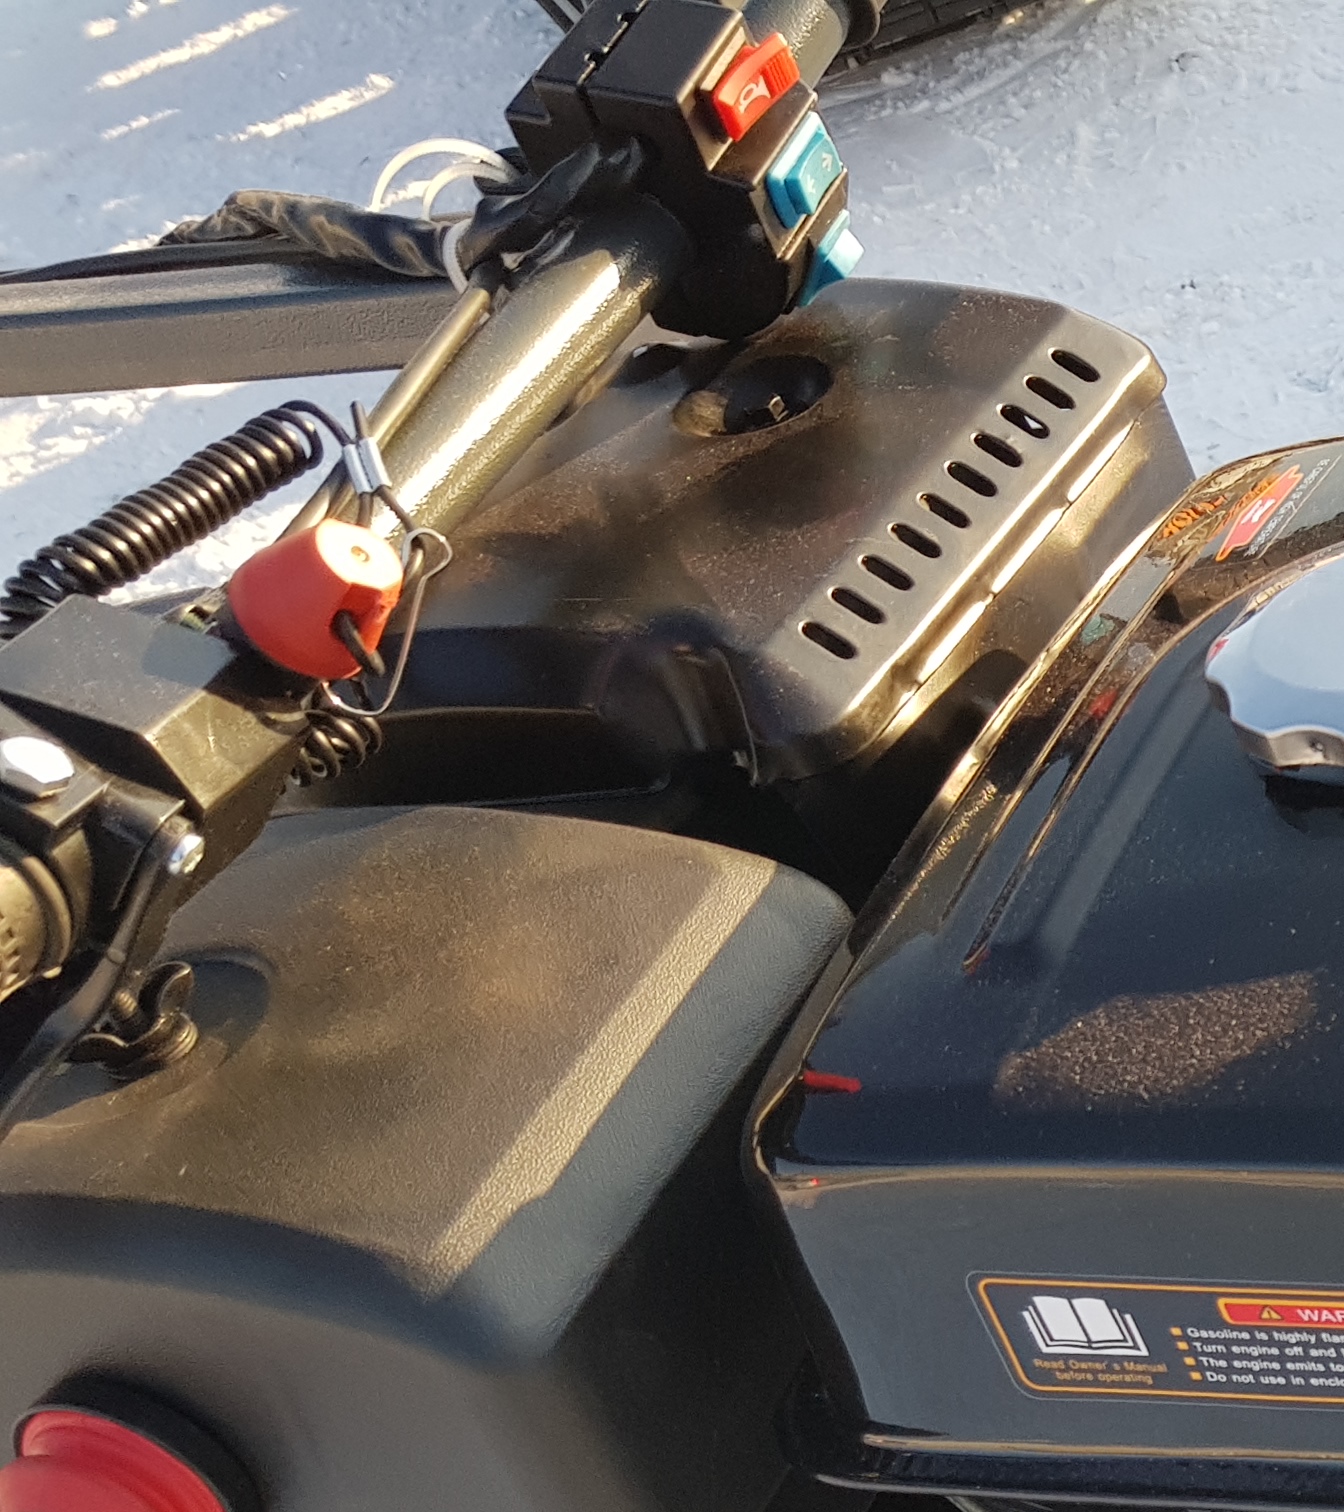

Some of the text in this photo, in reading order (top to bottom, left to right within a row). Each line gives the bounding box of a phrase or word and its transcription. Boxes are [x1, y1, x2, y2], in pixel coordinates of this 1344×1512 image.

[1186, 1327, 1251, 1340] Gasoline
[1255, 1330, 1268, 1341] is
[1272, 1331, 1317, 1344] highly
[1193, 1342, 1227, 1354] Turn
[1231, 1344, 1280, 1358] engine
[1284, 1346, 1304, 1356] off
[1309, 1347, 1337, 1358] and
[1032, 1358, 1066, 1370] Read
[1123, 1361, 1168, 1373] Manual
[1198, 1356, 1228, 1368] The
[1233, 1359, 1281, 1371] engine
[1285, 1360, 1325, 1372] emits
[1055, 1371, 1153, 1385] before operating
[1206, 1371, 1227, 1383] Do
[1232, 1374, 1256, 1384] not
[1260, 1375, 1286, 1385] use
[1291, 1374, 1305, 1386] in
